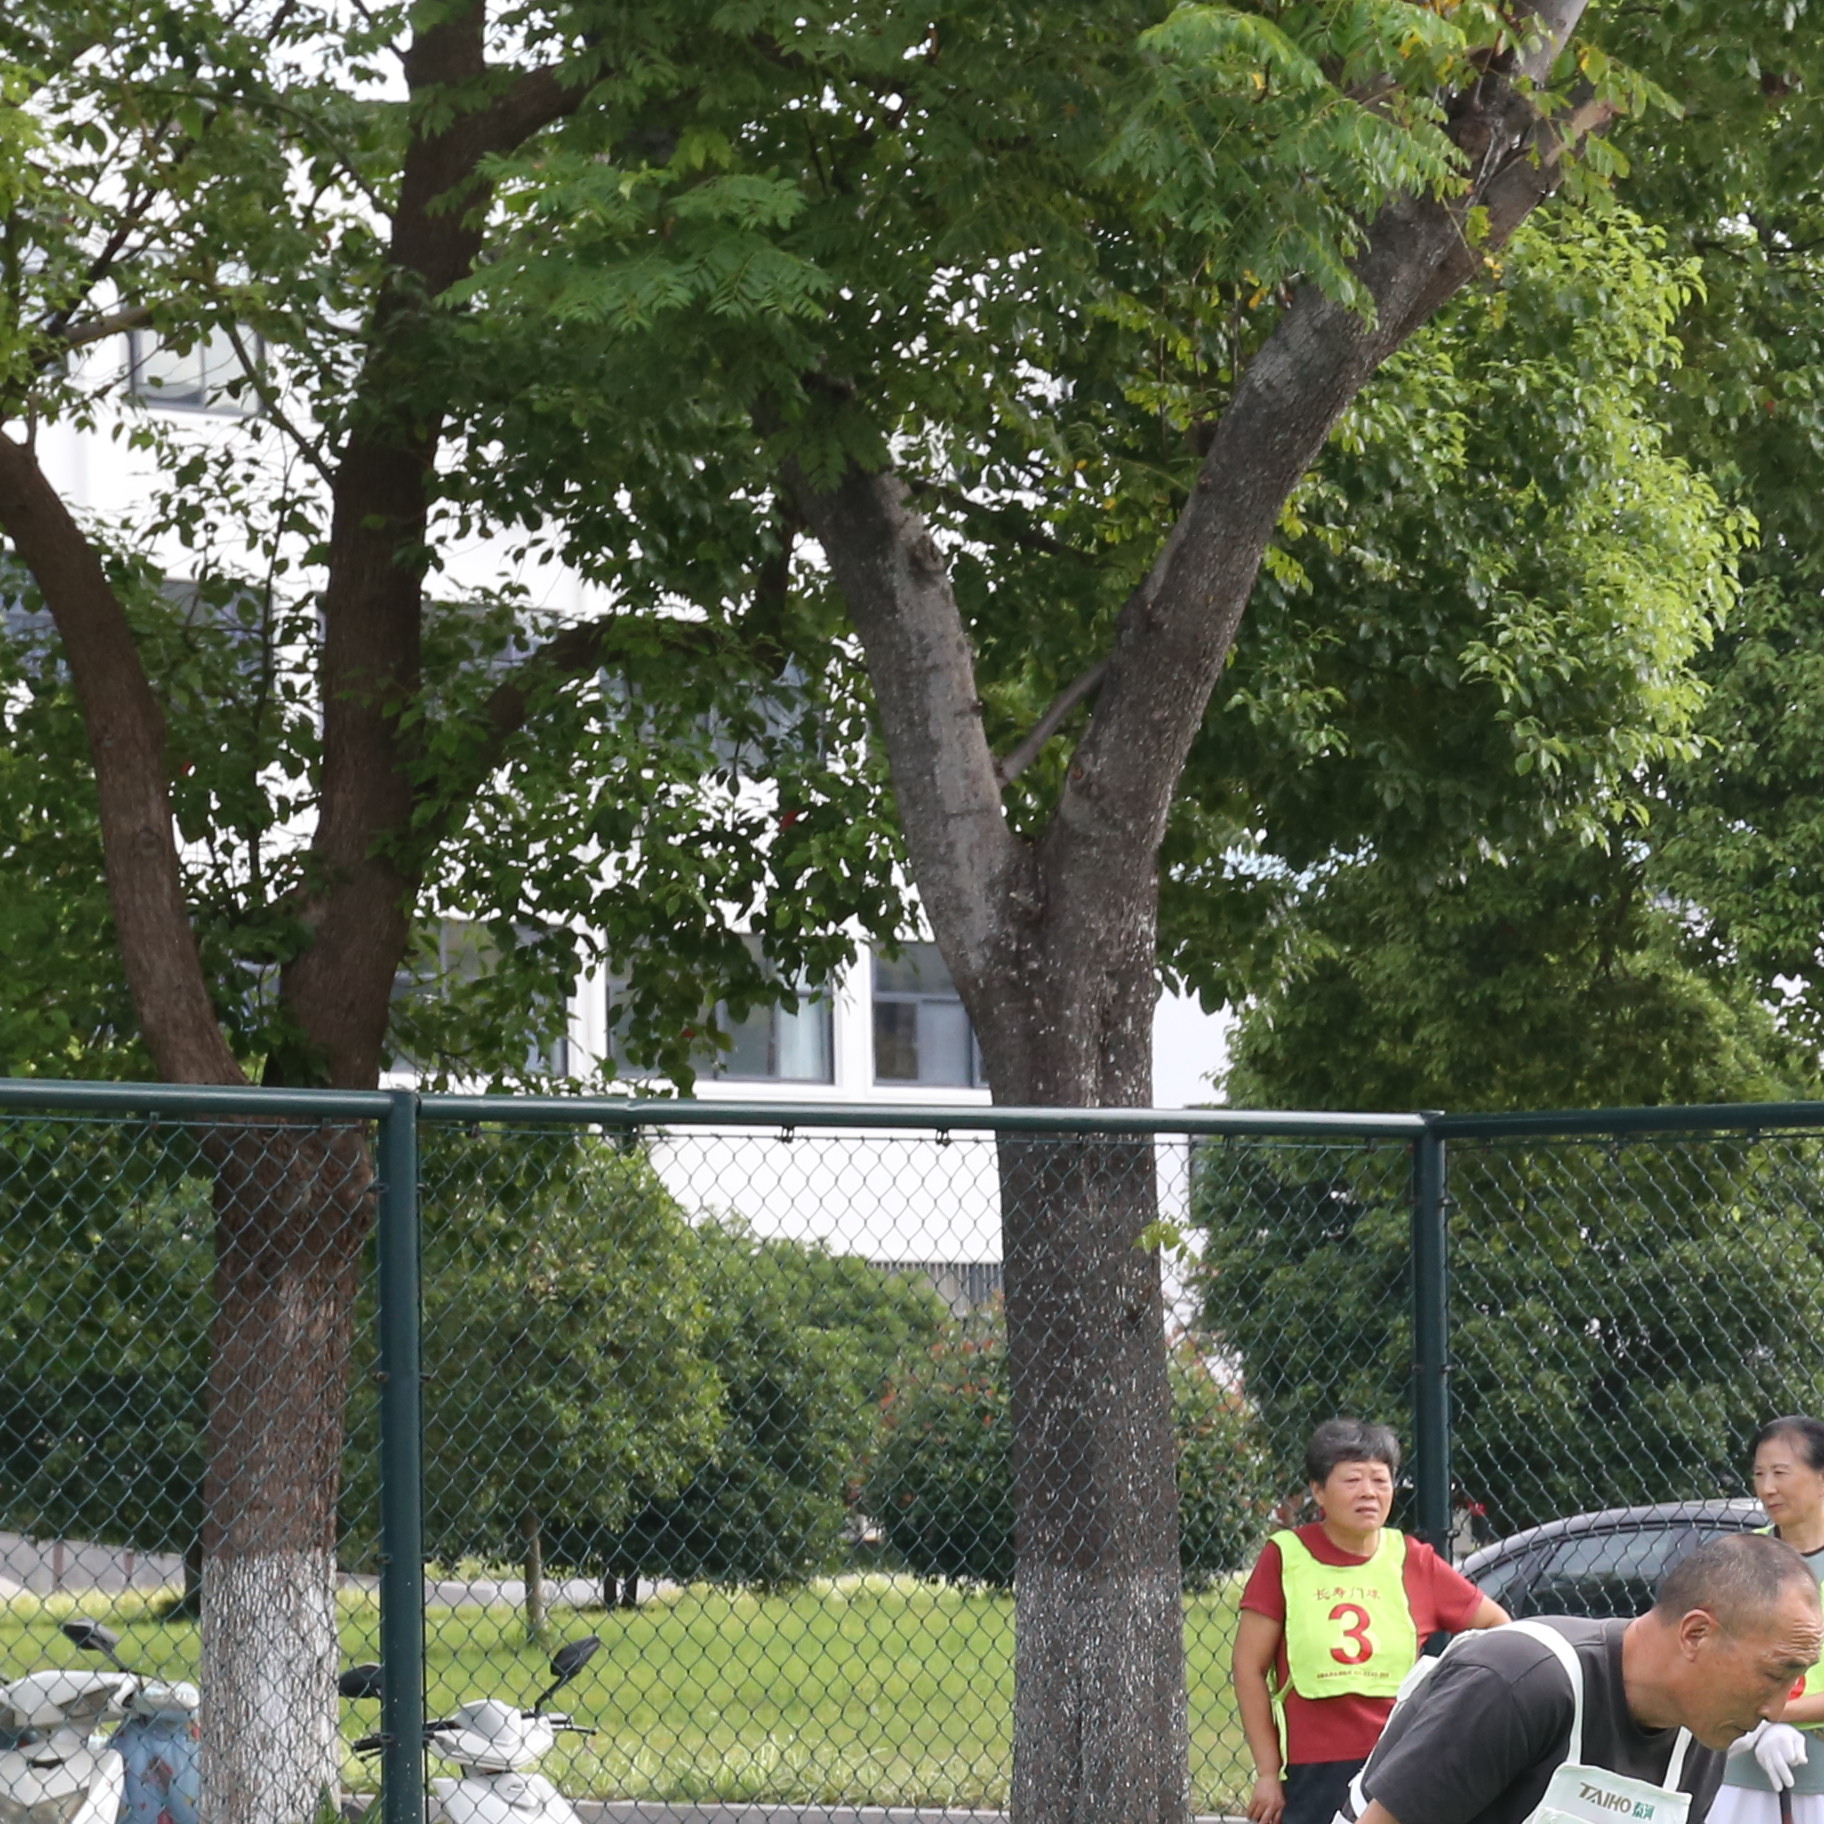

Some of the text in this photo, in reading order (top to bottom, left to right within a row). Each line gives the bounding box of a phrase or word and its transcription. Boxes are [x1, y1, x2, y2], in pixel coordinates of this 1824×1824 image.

[1328, 1602, 1374, 1665] 3
[1579, 1782, 1656, 1821] TAIHO 泰河
